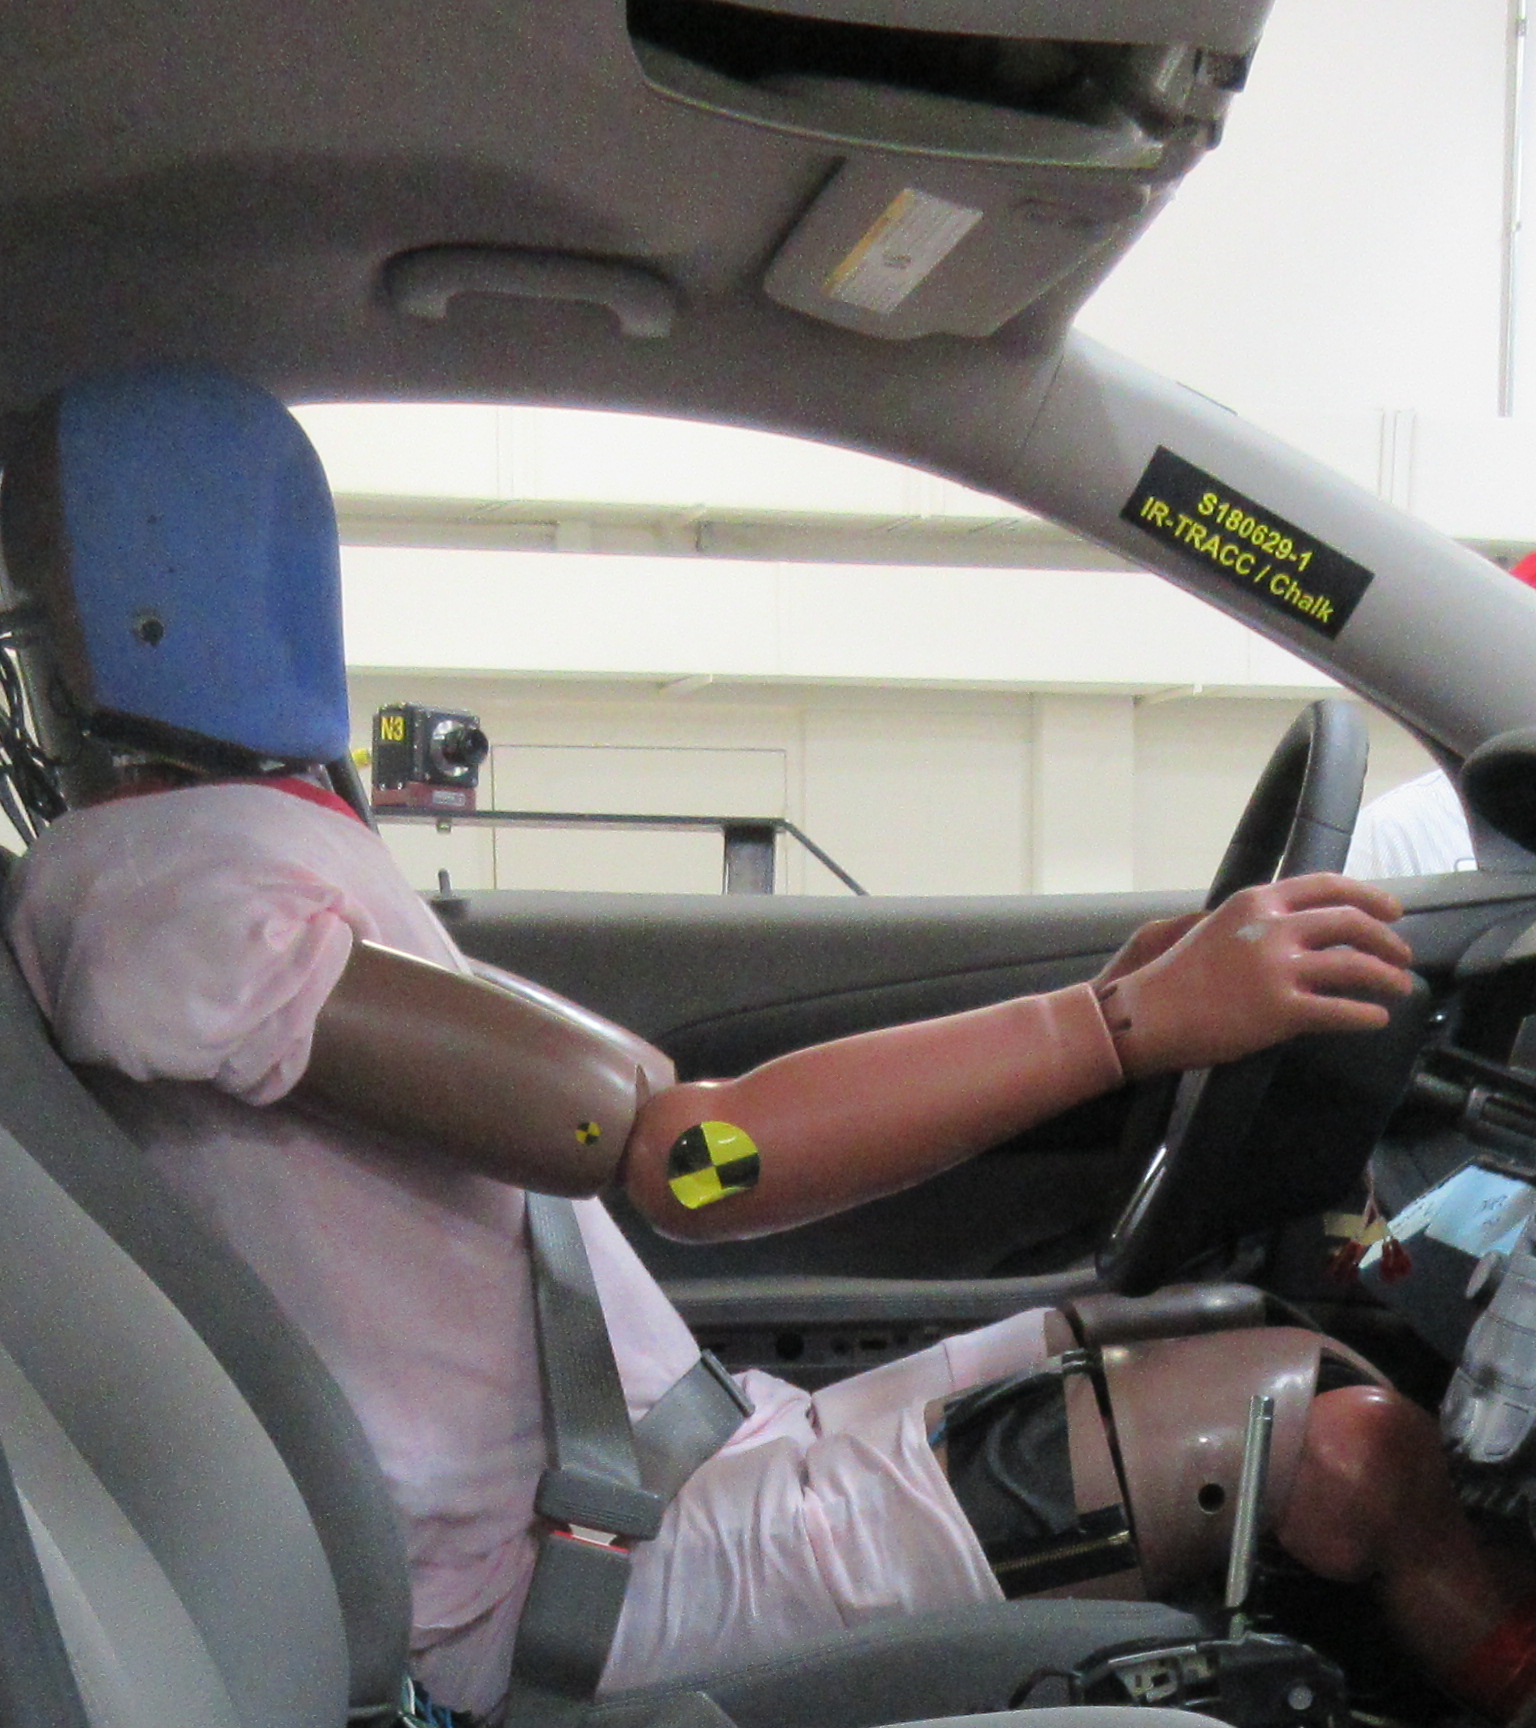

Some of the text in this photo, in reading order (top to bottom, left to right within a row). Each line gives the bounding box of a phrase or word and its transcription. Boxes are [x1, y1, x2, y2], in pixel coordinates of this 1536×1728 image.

[1139, 496, 1335, 623] IR-TRACC / Chalk
[1197, 492, 1313, 573] S180629-1
[380, 716, 406, 742] N3
